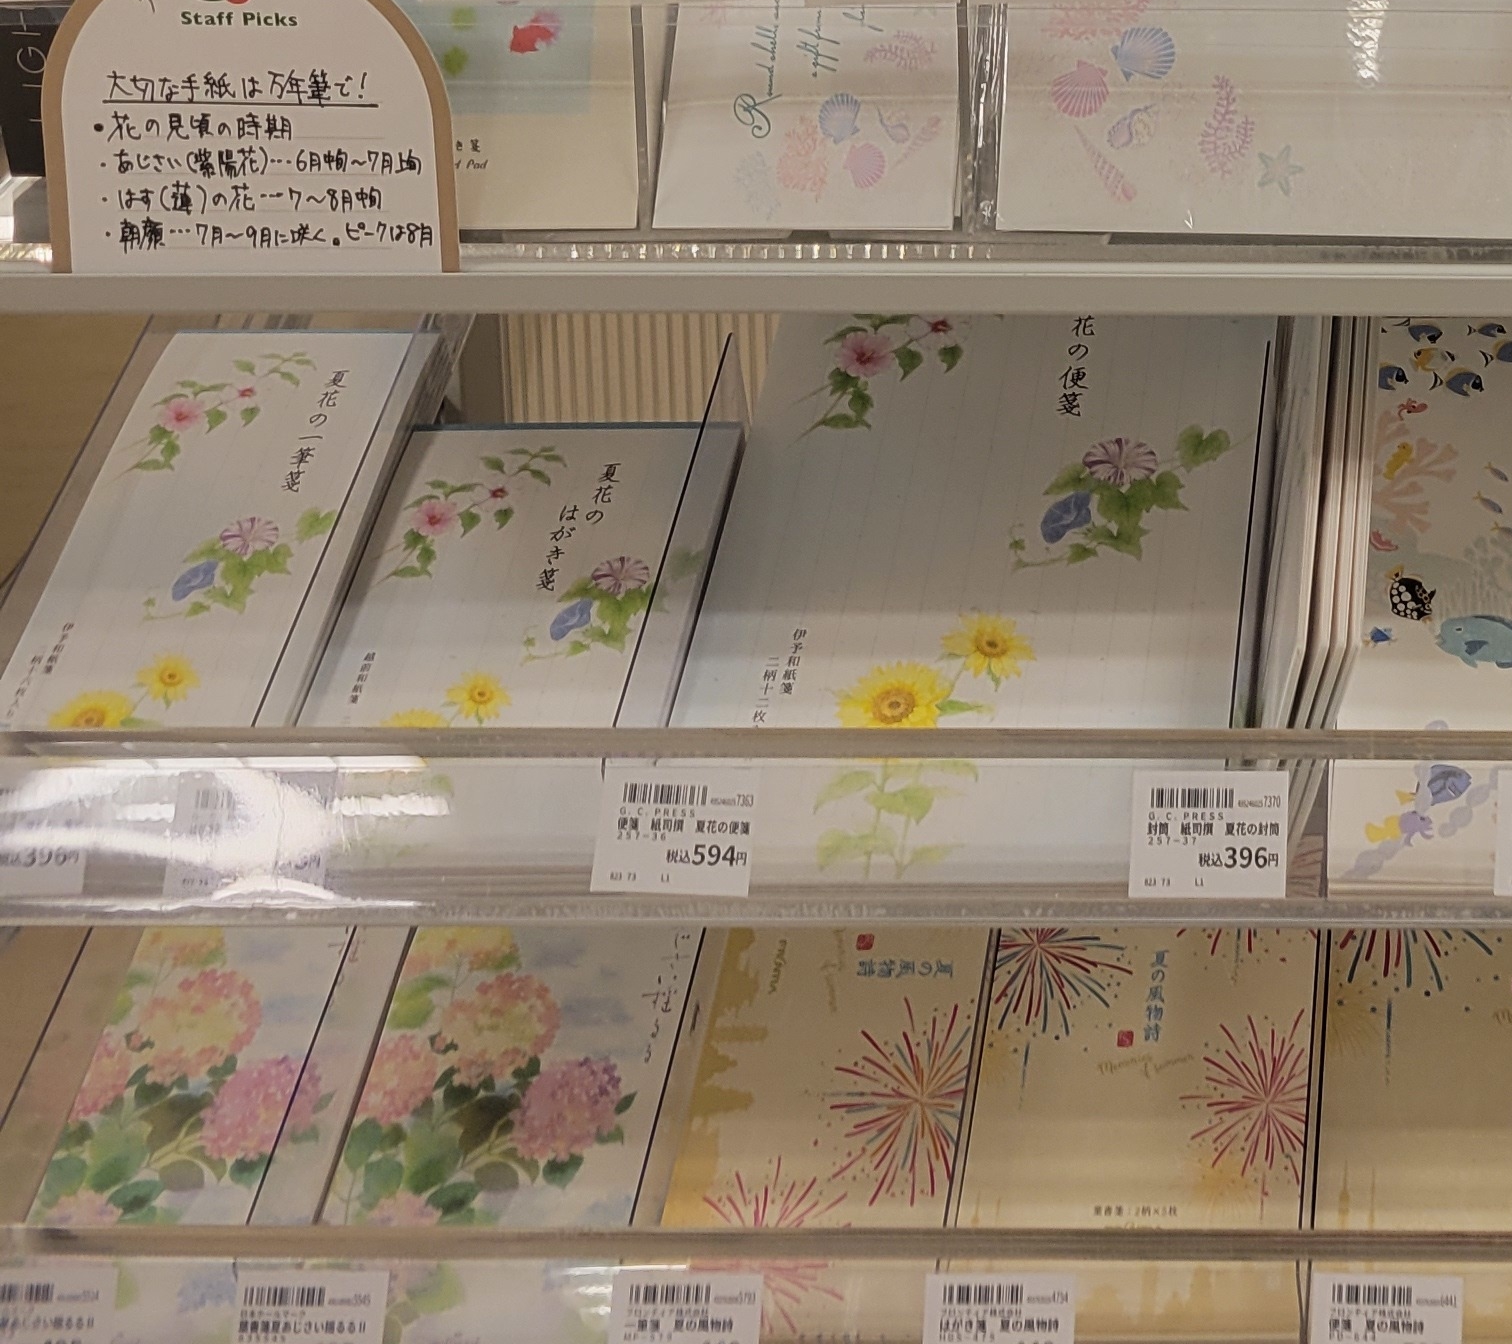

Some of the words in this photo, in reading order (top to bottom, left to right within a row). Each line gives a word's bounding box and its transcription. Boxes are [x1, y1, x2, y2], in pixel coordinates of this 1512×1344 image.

[180, 10, 233, 27] Staff
[242, 10, 299, 27] Picks
[585, 462, 622, 525] 夏花の
[665, 844, 748, 867] 税込594円
[1198, 846, 1280, 869] 税込396円
